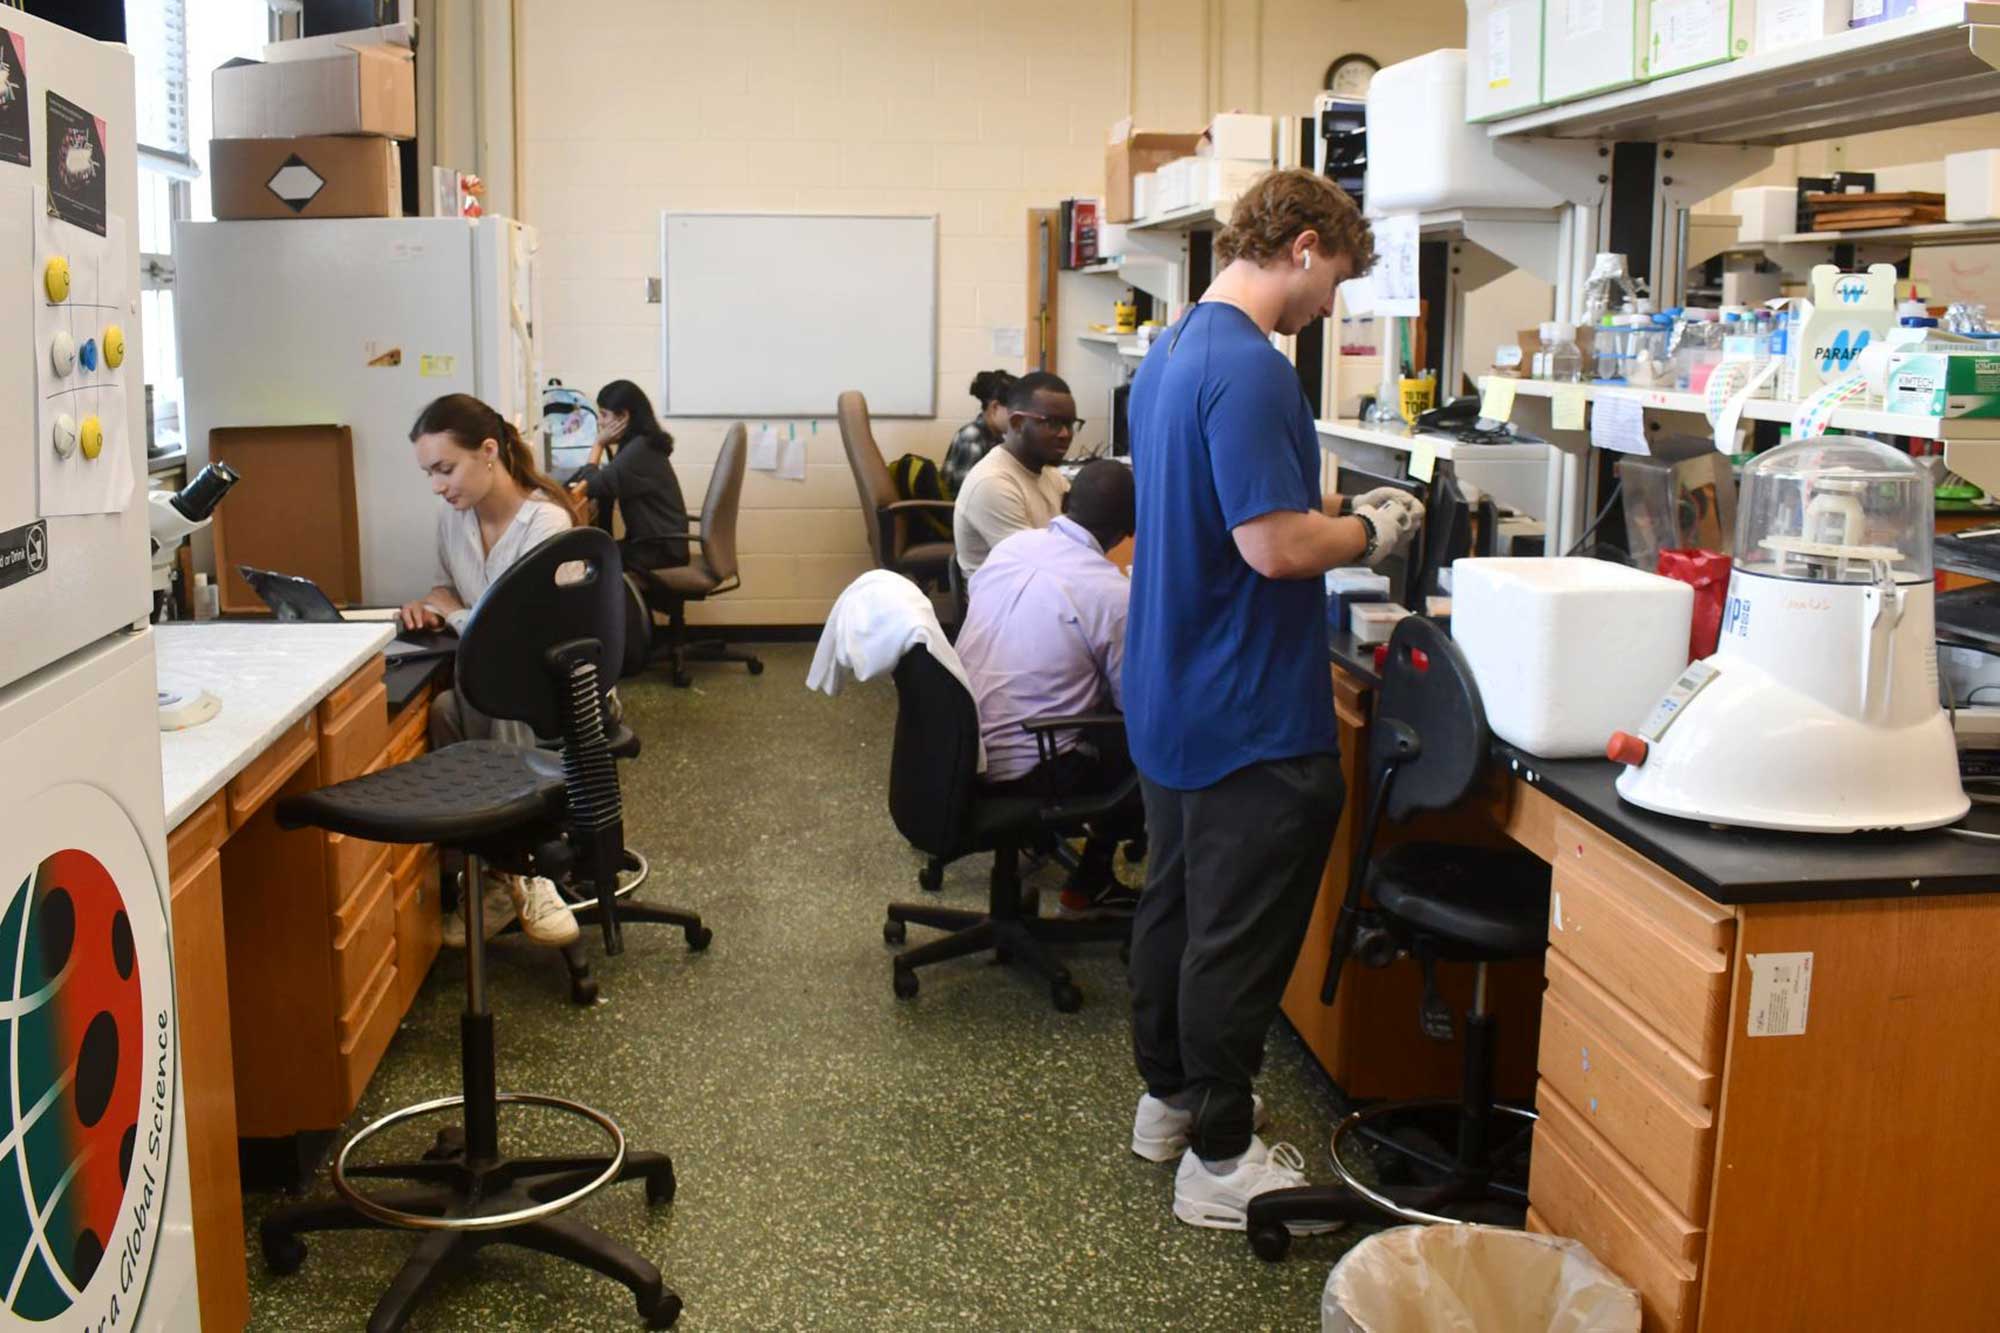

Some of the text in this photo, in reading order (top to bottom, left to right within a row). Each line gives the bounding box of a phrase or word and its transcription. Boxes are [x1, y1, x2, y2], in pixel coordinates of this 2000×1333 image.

[110, 1008, 169, 1326] a Global Science
